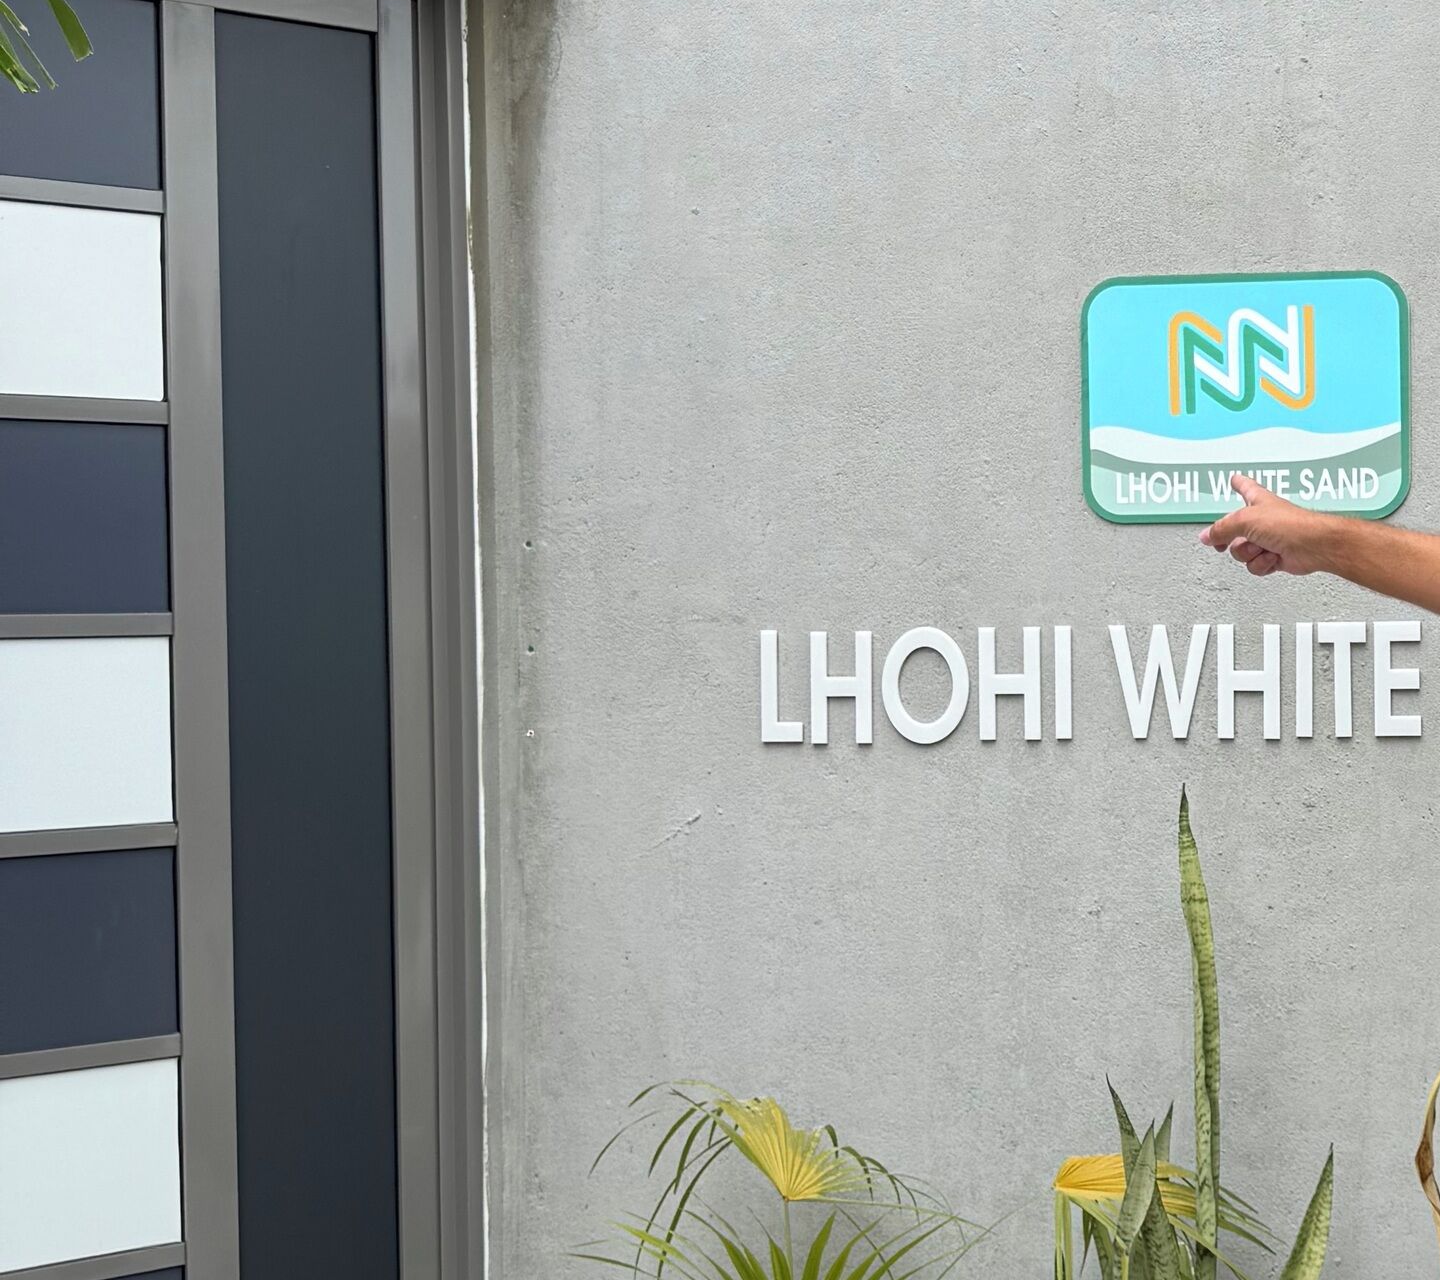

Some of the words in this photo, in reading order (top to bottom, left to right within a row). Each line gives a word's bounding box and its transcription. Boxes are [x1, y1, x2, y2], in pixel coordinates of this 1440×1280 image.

[1115, 471, 1200, 504] LHOHI
[1299, 467, 1380, 500] SAND
[760, 626, 1073, 744] LHOHI
[1107, 620, 1422, 739] WHITE
